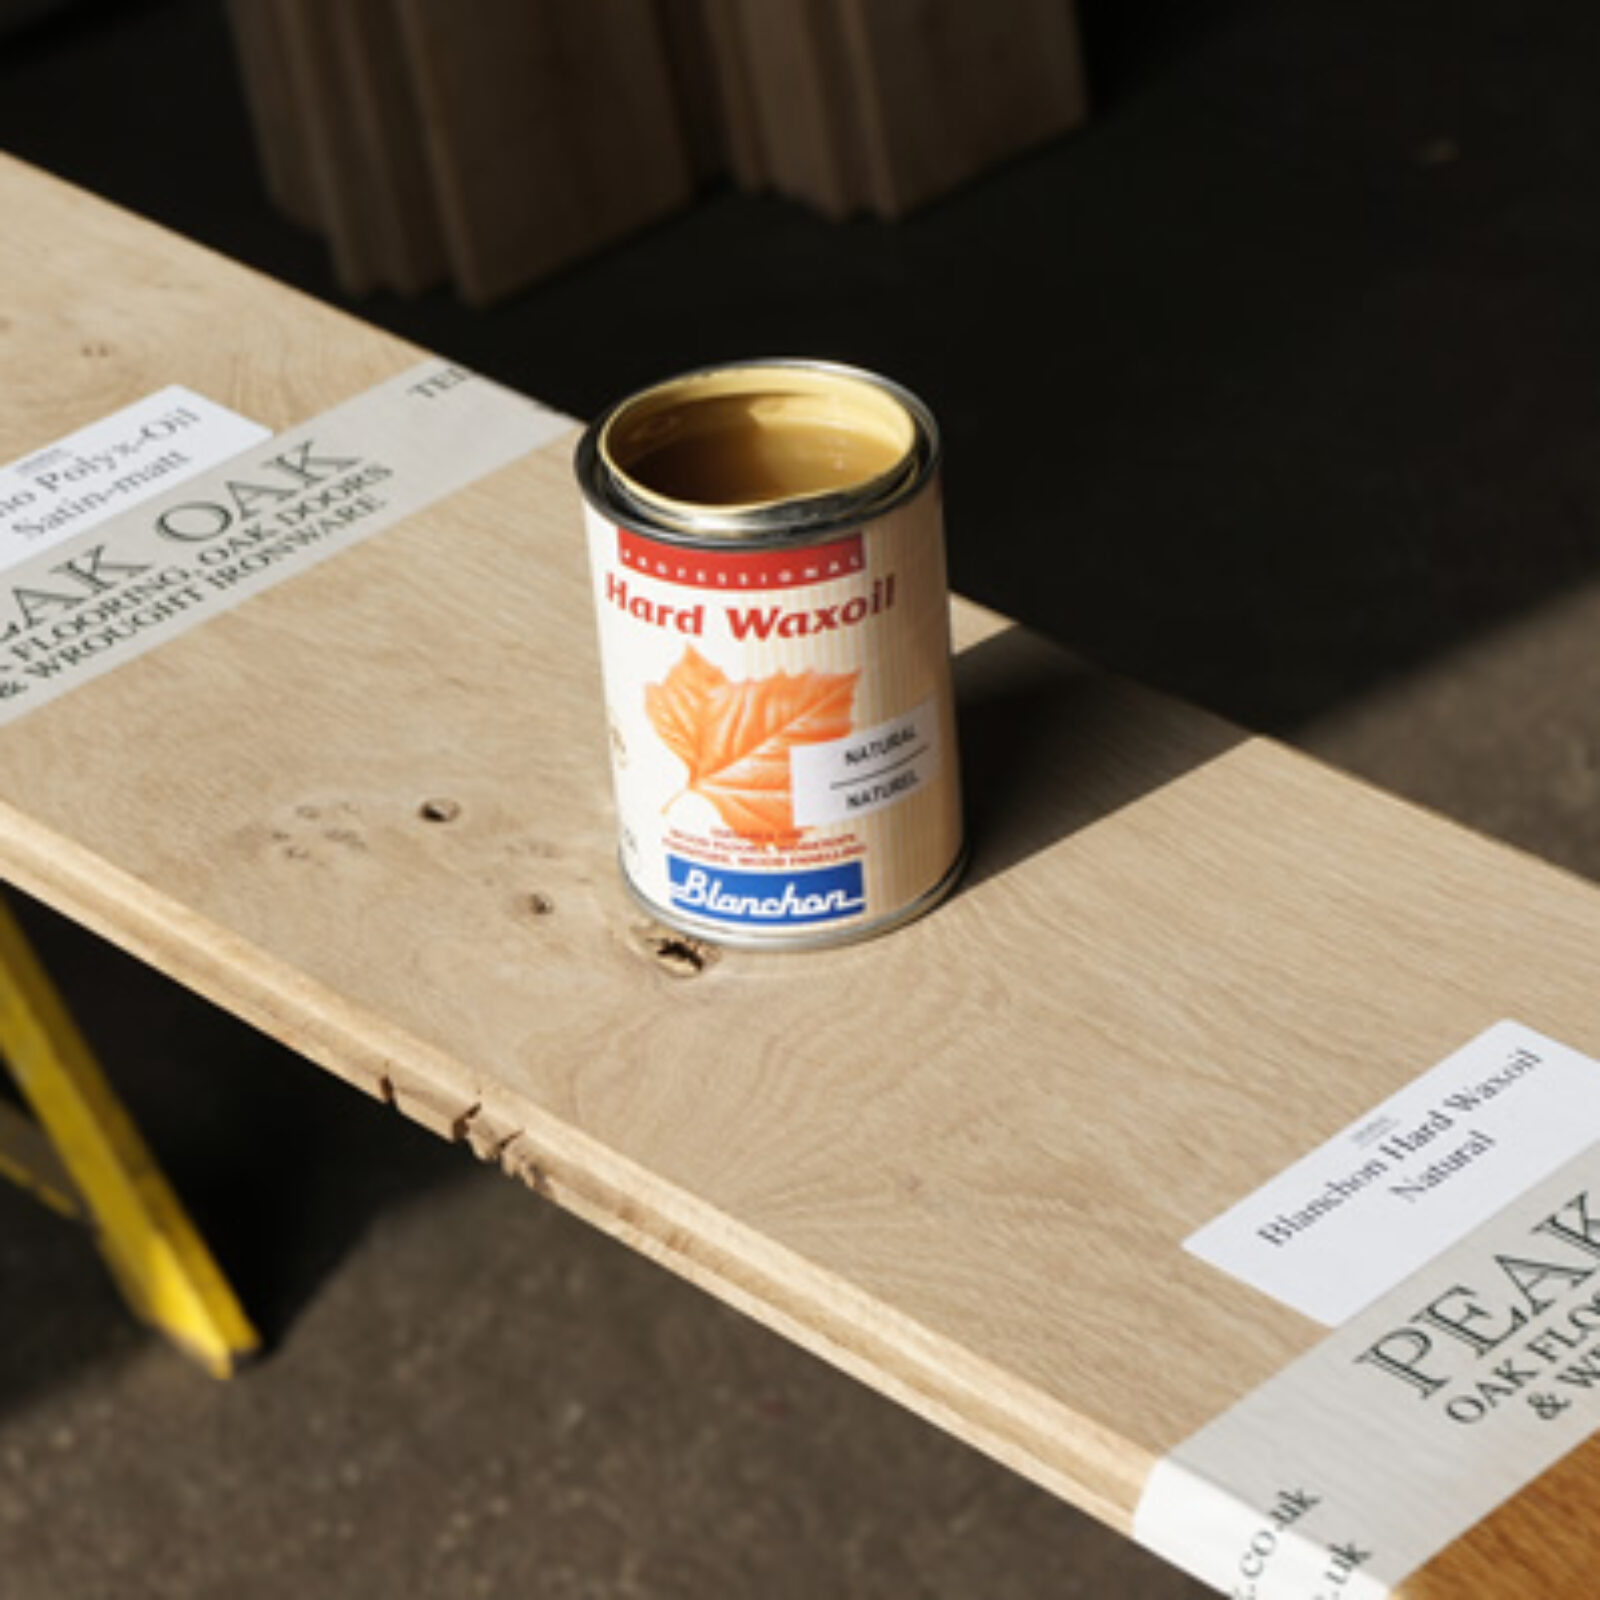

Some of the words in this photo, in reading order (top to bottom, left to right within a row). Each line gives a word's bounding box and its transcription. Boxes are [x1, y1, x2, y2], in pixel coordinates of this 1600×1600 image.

[35, 406, 201, 494] Polyx-Oil
[12, 450, 190, 538] Satin-matt
[197, 521, 281, 567] OAK
[274, 463, 393, 526] DOORS
[0, 543, 151, 642] AK
[155, 439, 363, 544] OAK
[623, 549, 861, 584] PROFESSIONAL
[23, 586, 206, 679] WROUGHT
[206, 493, 388, 591] IRONWARE
[604, 572, 705, 635] Hard
[725, 573, 896, 641] Waxoil
[845, 724, 917, 766] NATURAL
[846, 769, 920, 811] NATUREL
[670, 868, 866, 918] Blanchon
[1256, 1158, 1390, 1247] Blanchon
[1377, 1109, 1456, 1161] Hard
[1443, 1047, 1544, 1112] Waxoil
[1387, 1129, 1497, 1204] Natural
[1445, 1358, 1540, 1424] OAK
[1525, 1290, 1600, 1364] FLO
[1526, 1392, 1572, 1420] &
